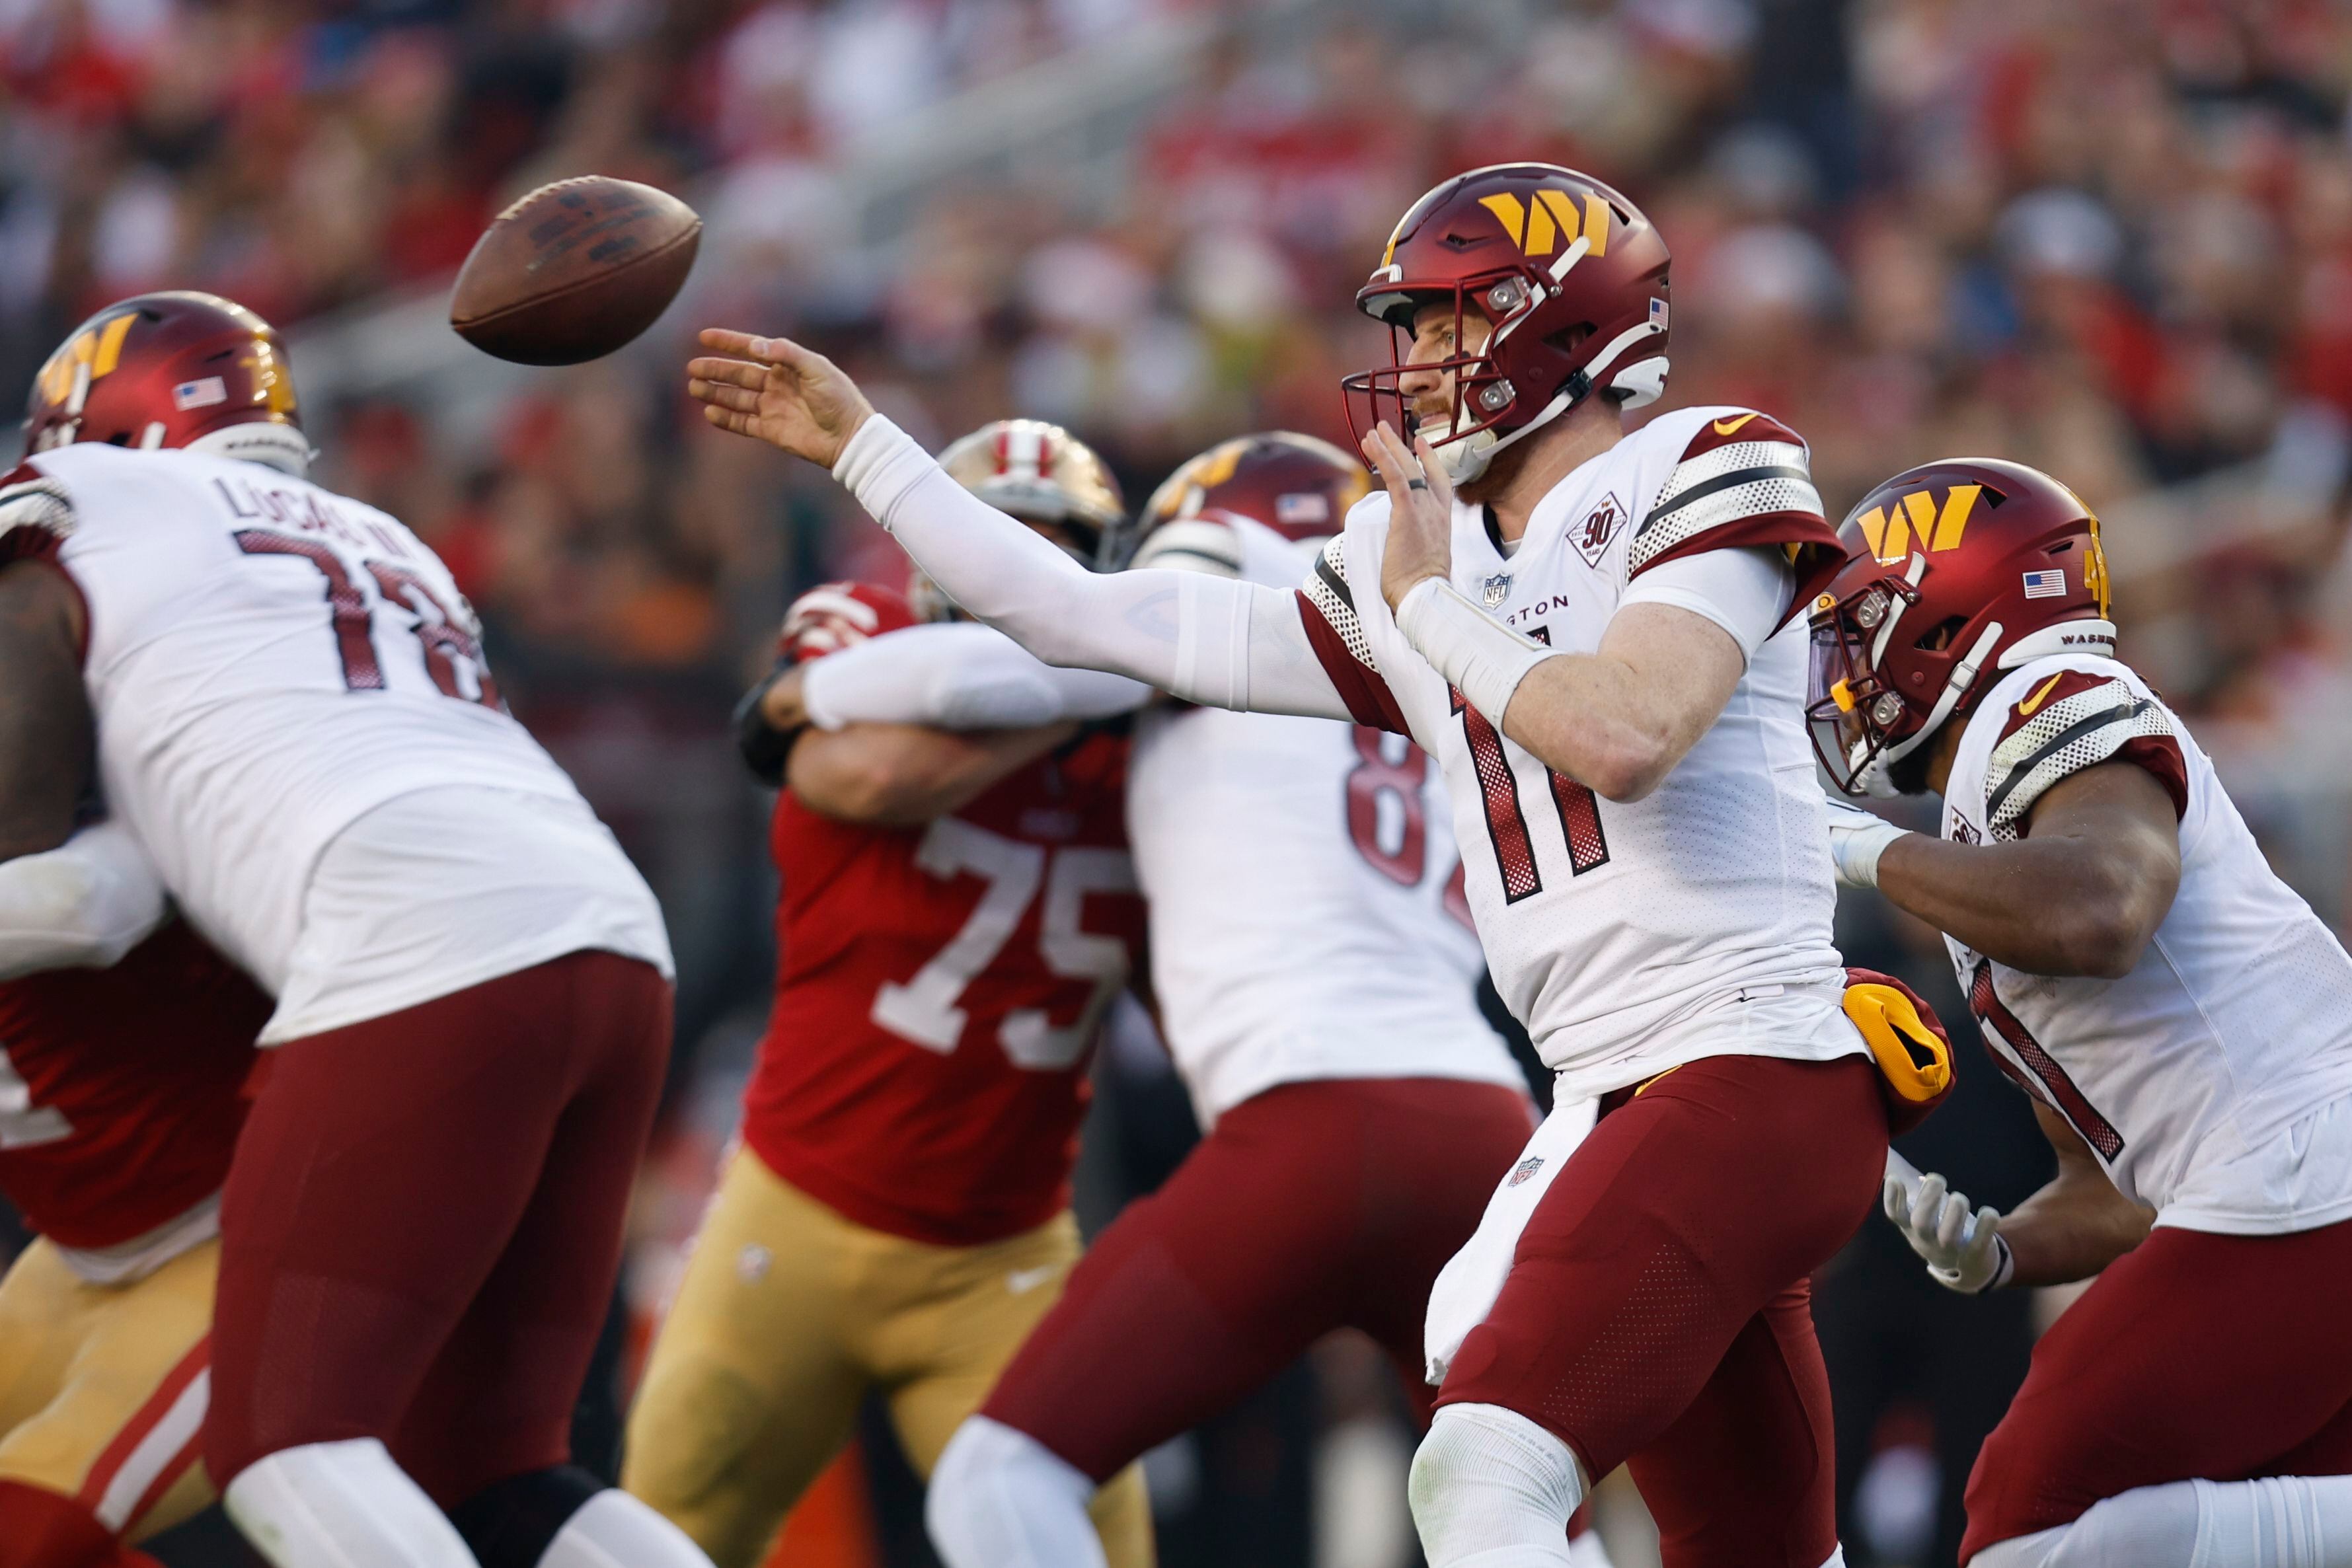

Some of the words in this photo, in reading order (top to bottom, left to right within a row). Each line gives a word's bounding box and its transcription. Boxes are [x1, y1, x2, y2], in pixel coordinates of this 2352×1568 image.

[1582, 507, 1615, 549] 90
[1585, 548, 1601, 558] YEARS
[1486, 585, 1504, 602] NFL
[870, 815, 1134, 1072] 75
[1511, 1170, 1533, 1185] NFL
